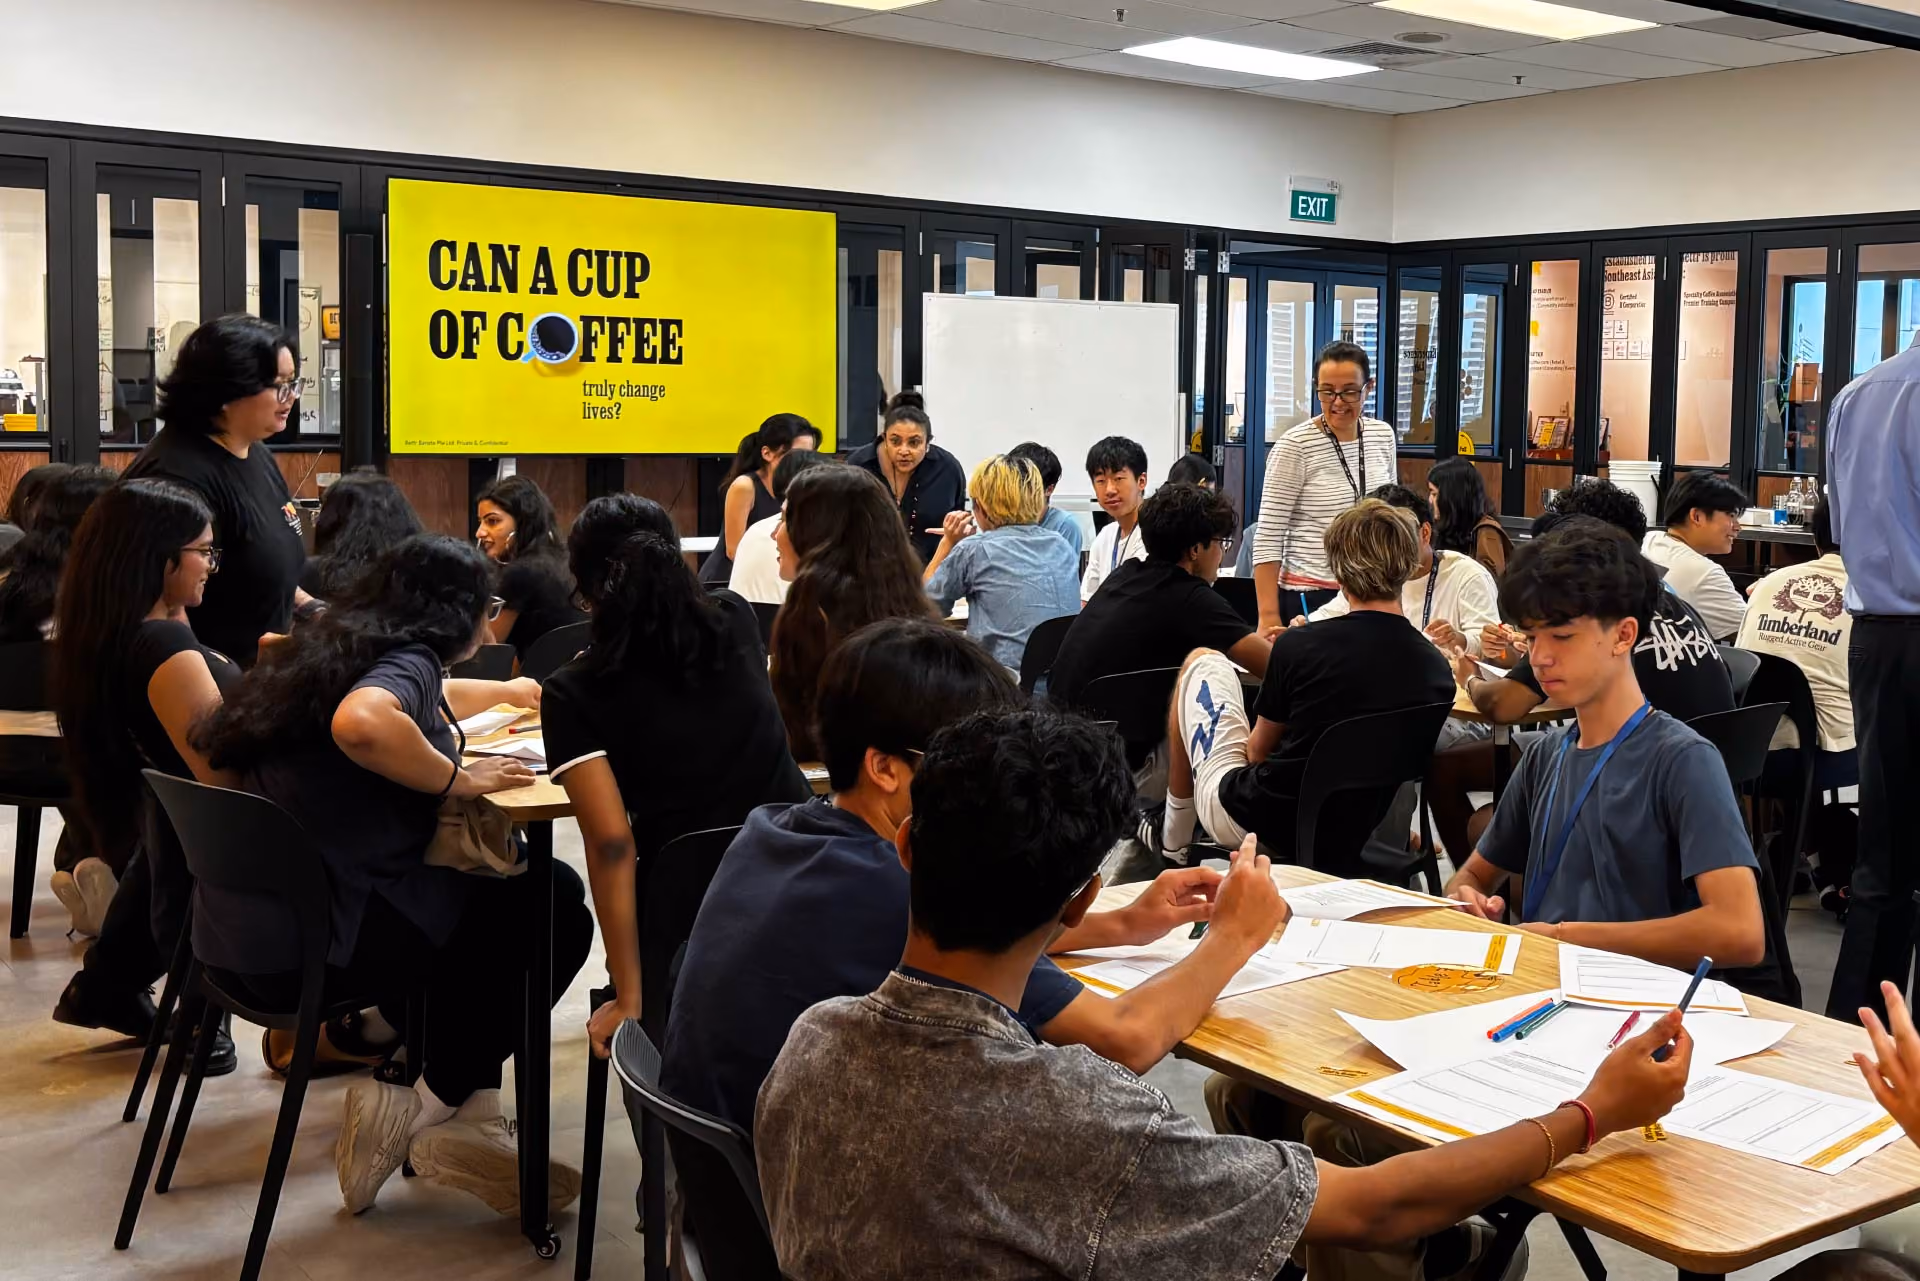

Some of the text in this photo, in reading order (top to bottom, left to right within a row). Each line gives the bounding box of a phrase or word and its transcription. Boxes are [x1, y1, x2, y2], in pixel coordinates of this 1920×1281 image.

[1298, 195, 1329, 217] EXIT
[429, 239, 651, 299] CAN A CUP
[1605, 268, 1655, 282] Southeast Asi
[429, 309, 487, 360] OF
[583, 379, 666, 402] truly change
[582, 401, 622, 420] lives?
[1757, 613, 1843, 646] Timberland
[1758, 632, 1827, 651] Rugged Active Gear
